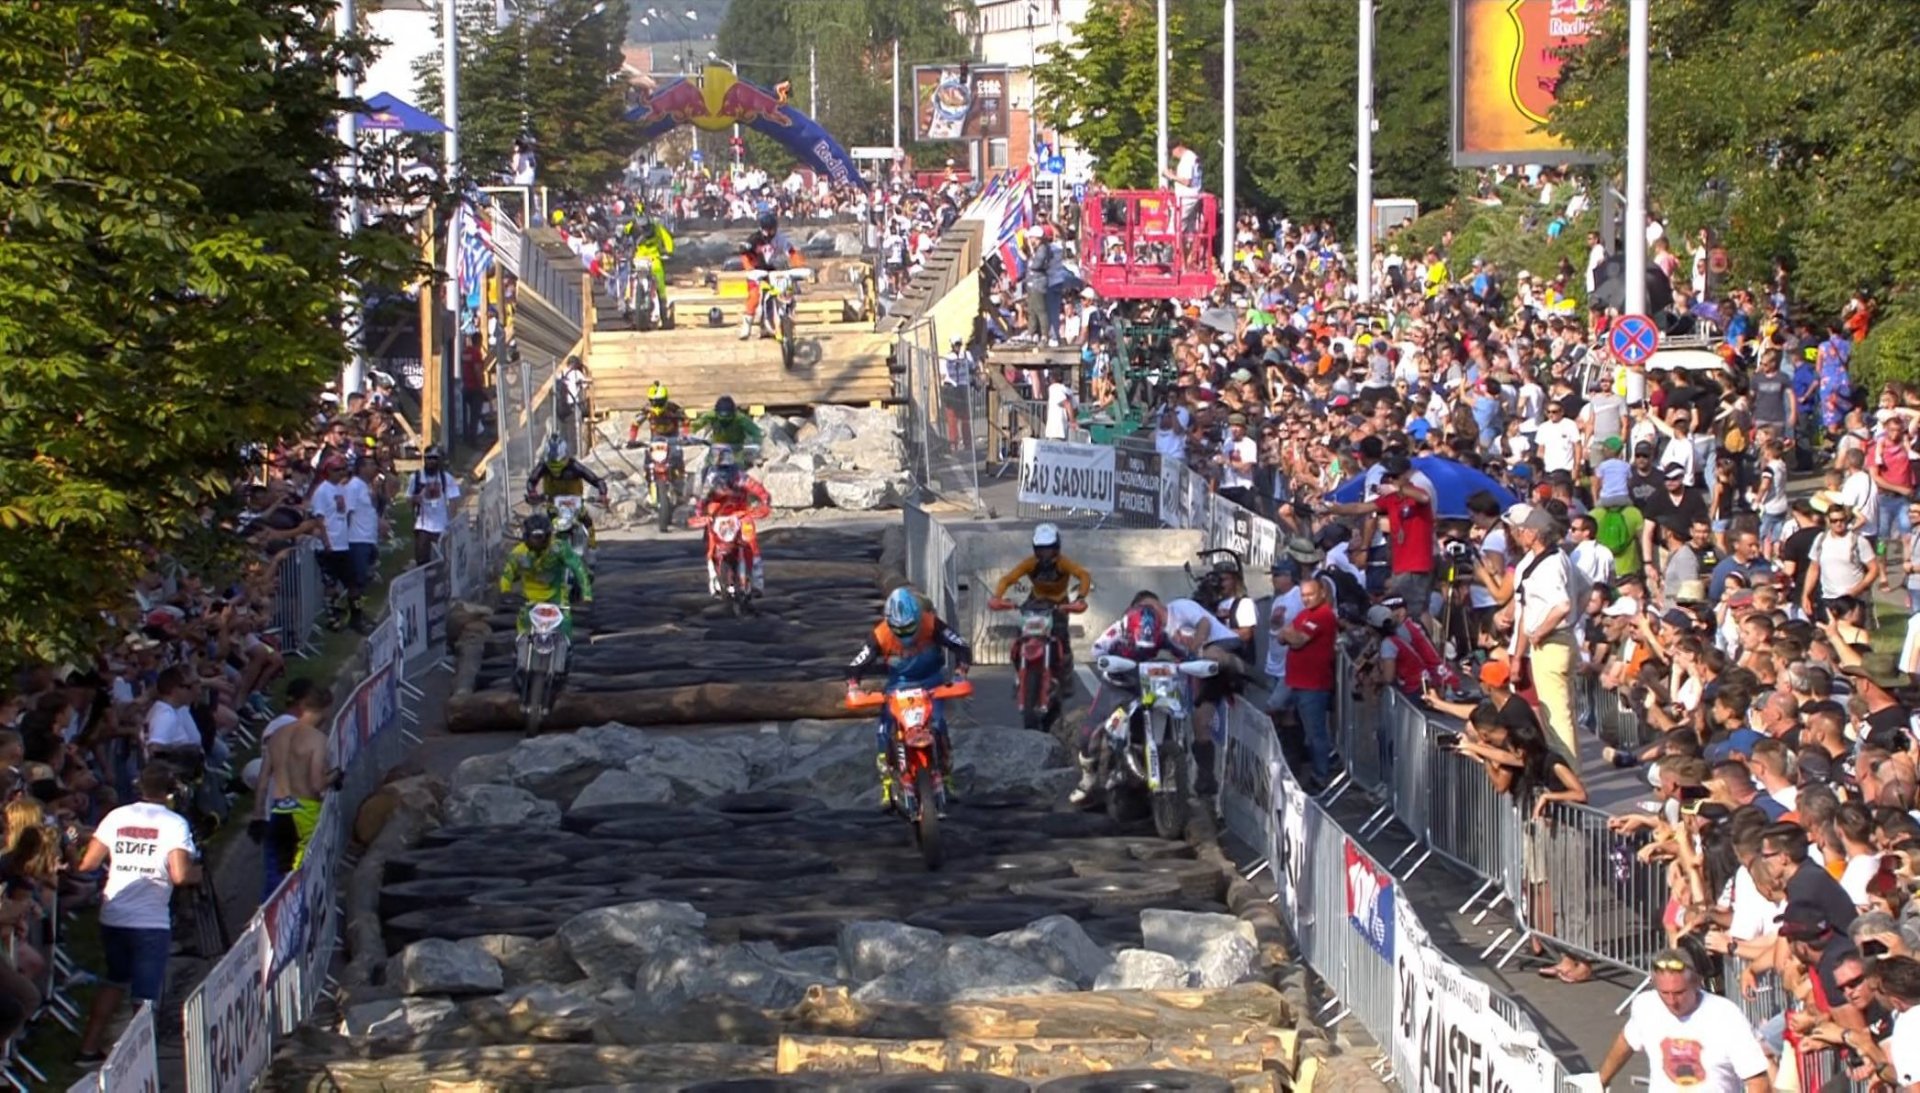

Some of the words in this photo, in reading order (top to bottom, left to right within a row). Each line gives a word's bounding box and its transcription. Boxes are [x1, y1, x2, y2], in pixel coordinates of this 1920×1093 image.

[813, 140, 843, 171] Red
[1024, 456, 1050, 495] RÂU
[1053, 465, 1113, 502] SADULUI
